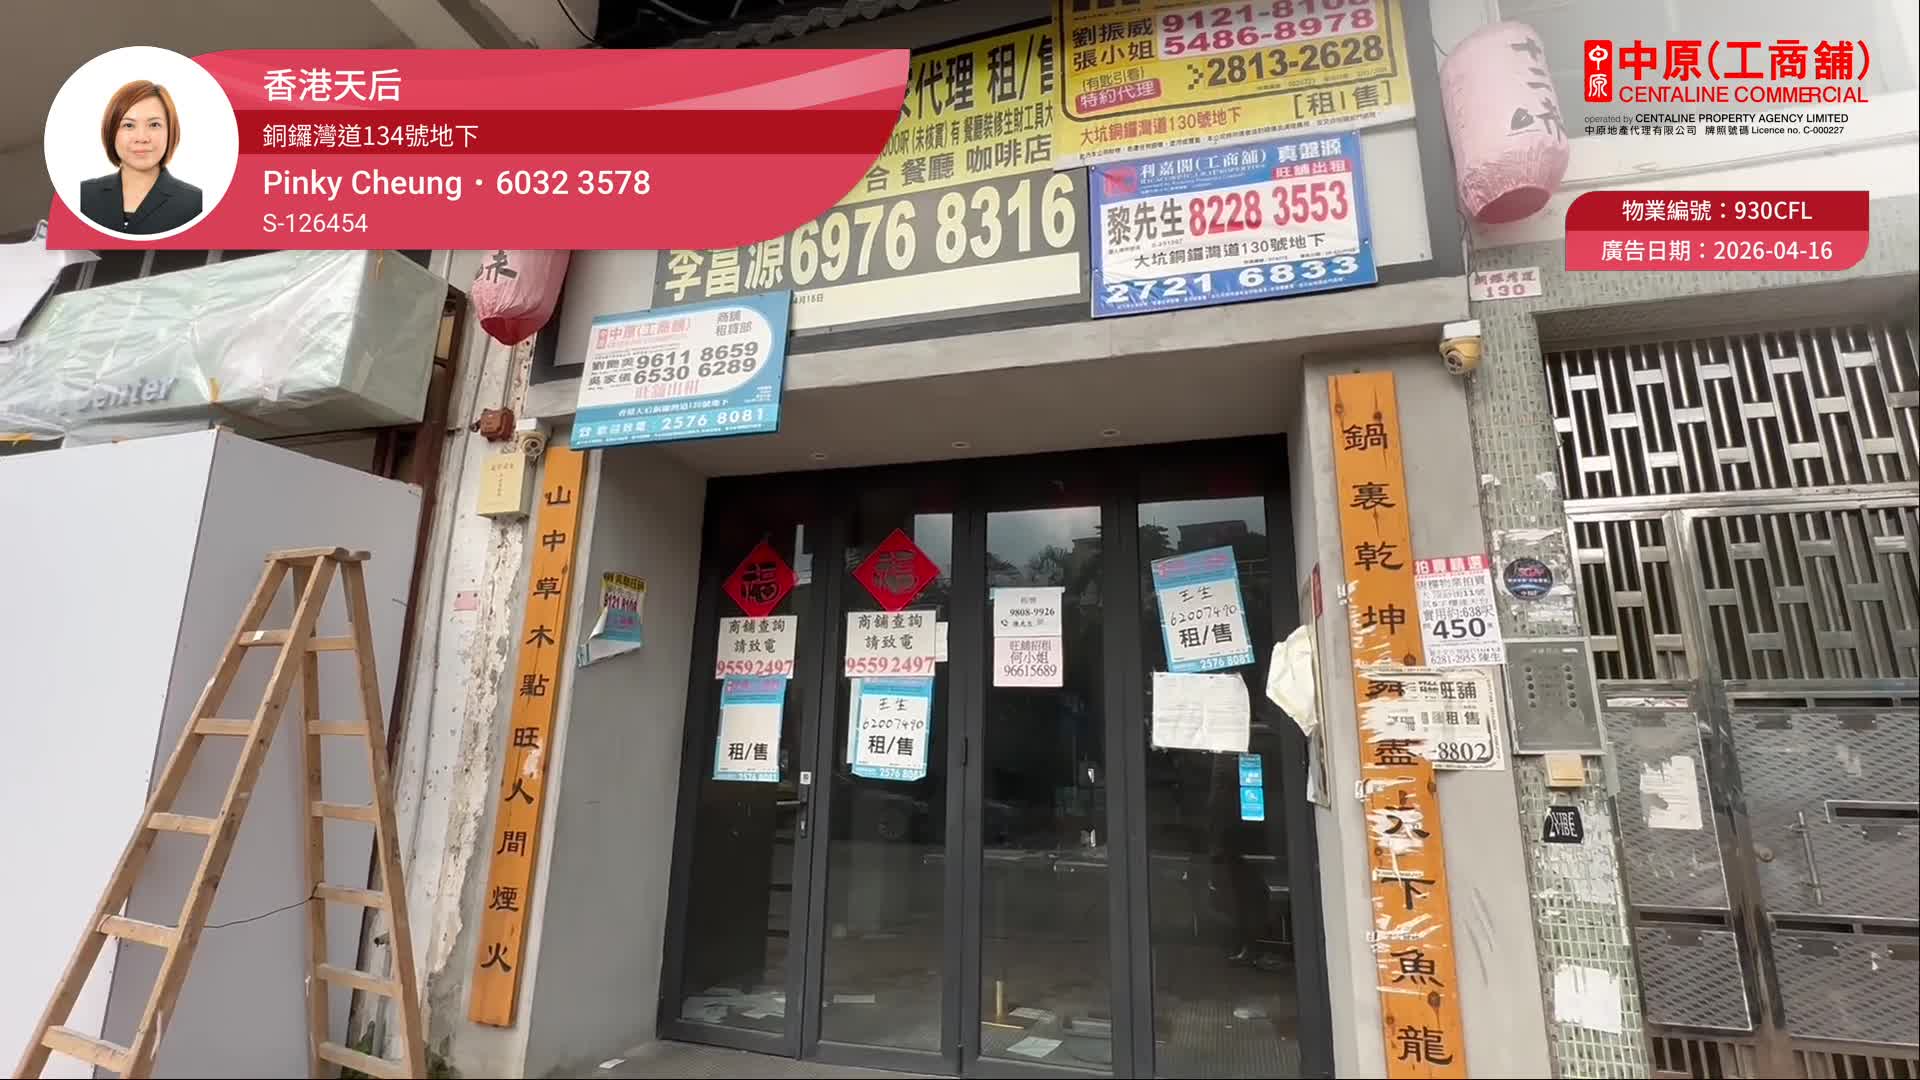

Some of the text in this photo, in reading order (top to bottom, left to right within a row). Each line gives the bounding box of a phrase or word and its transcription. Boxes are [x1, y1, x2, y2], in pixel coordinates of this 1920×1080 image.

[1072, 17, 1154, 48] 劉振威
[1164, 8, 1374, 54] 5486-8978
[1074, 41, 1155, 71] 張小姐
[1207, 35, 1384, 87] 2813-2628
[1080, 80, 1155, 109] 特約代理
[1080, 106, 1241, 147] 大坑銅鑼灣道130號地下
[1277, 137, 1341, 163] 真盤源
[866, 166, 890, 193] 合
[901, 152, 955, 187] 餐廳
[966, 134, 1053, 174] 咖啡店
[1107, 180, 1348, 246] 黎先生 8228 3553
[665, 173, 1076, 301] 李富源 6976 8316
[1134, 231, 1325, 269] 大坑銅鑼灣道130號地下
[1105, 273, 1211, 304] 2721
[1238, 255, 1358, 288] 6833
[1486, 284, 1525, 297] 130
[636, 349, 690, 369] 9611
[700, 341, 758, 361] 8659
[633, 365, 690, 385] 6530
[698, 358, 756, 377] 6289
[662, 414, 708, 431] 2576
[716, 407, 763, 424] 8081
[857, 614, 923, 630] 商舖查詢
[1009, 607, 1055, 617] 9808-9926
[728, 619, 785, 634] 商舖查詢
[1178, 623, 1232, 648] 租/售
[1432, 617, 1487, 640] 450
[734, 638, 776, 653] 請致電
[865, 634, 914, 650] 請致電
[1010, 651, 1048, 664] 何小姐
[1200, 656, 1225, 669] 2576
[1004, 664, 1057, 677] 96615689
[728, 742, 768, 760] 租/售
[868, 735, 914, 756] 租/售
